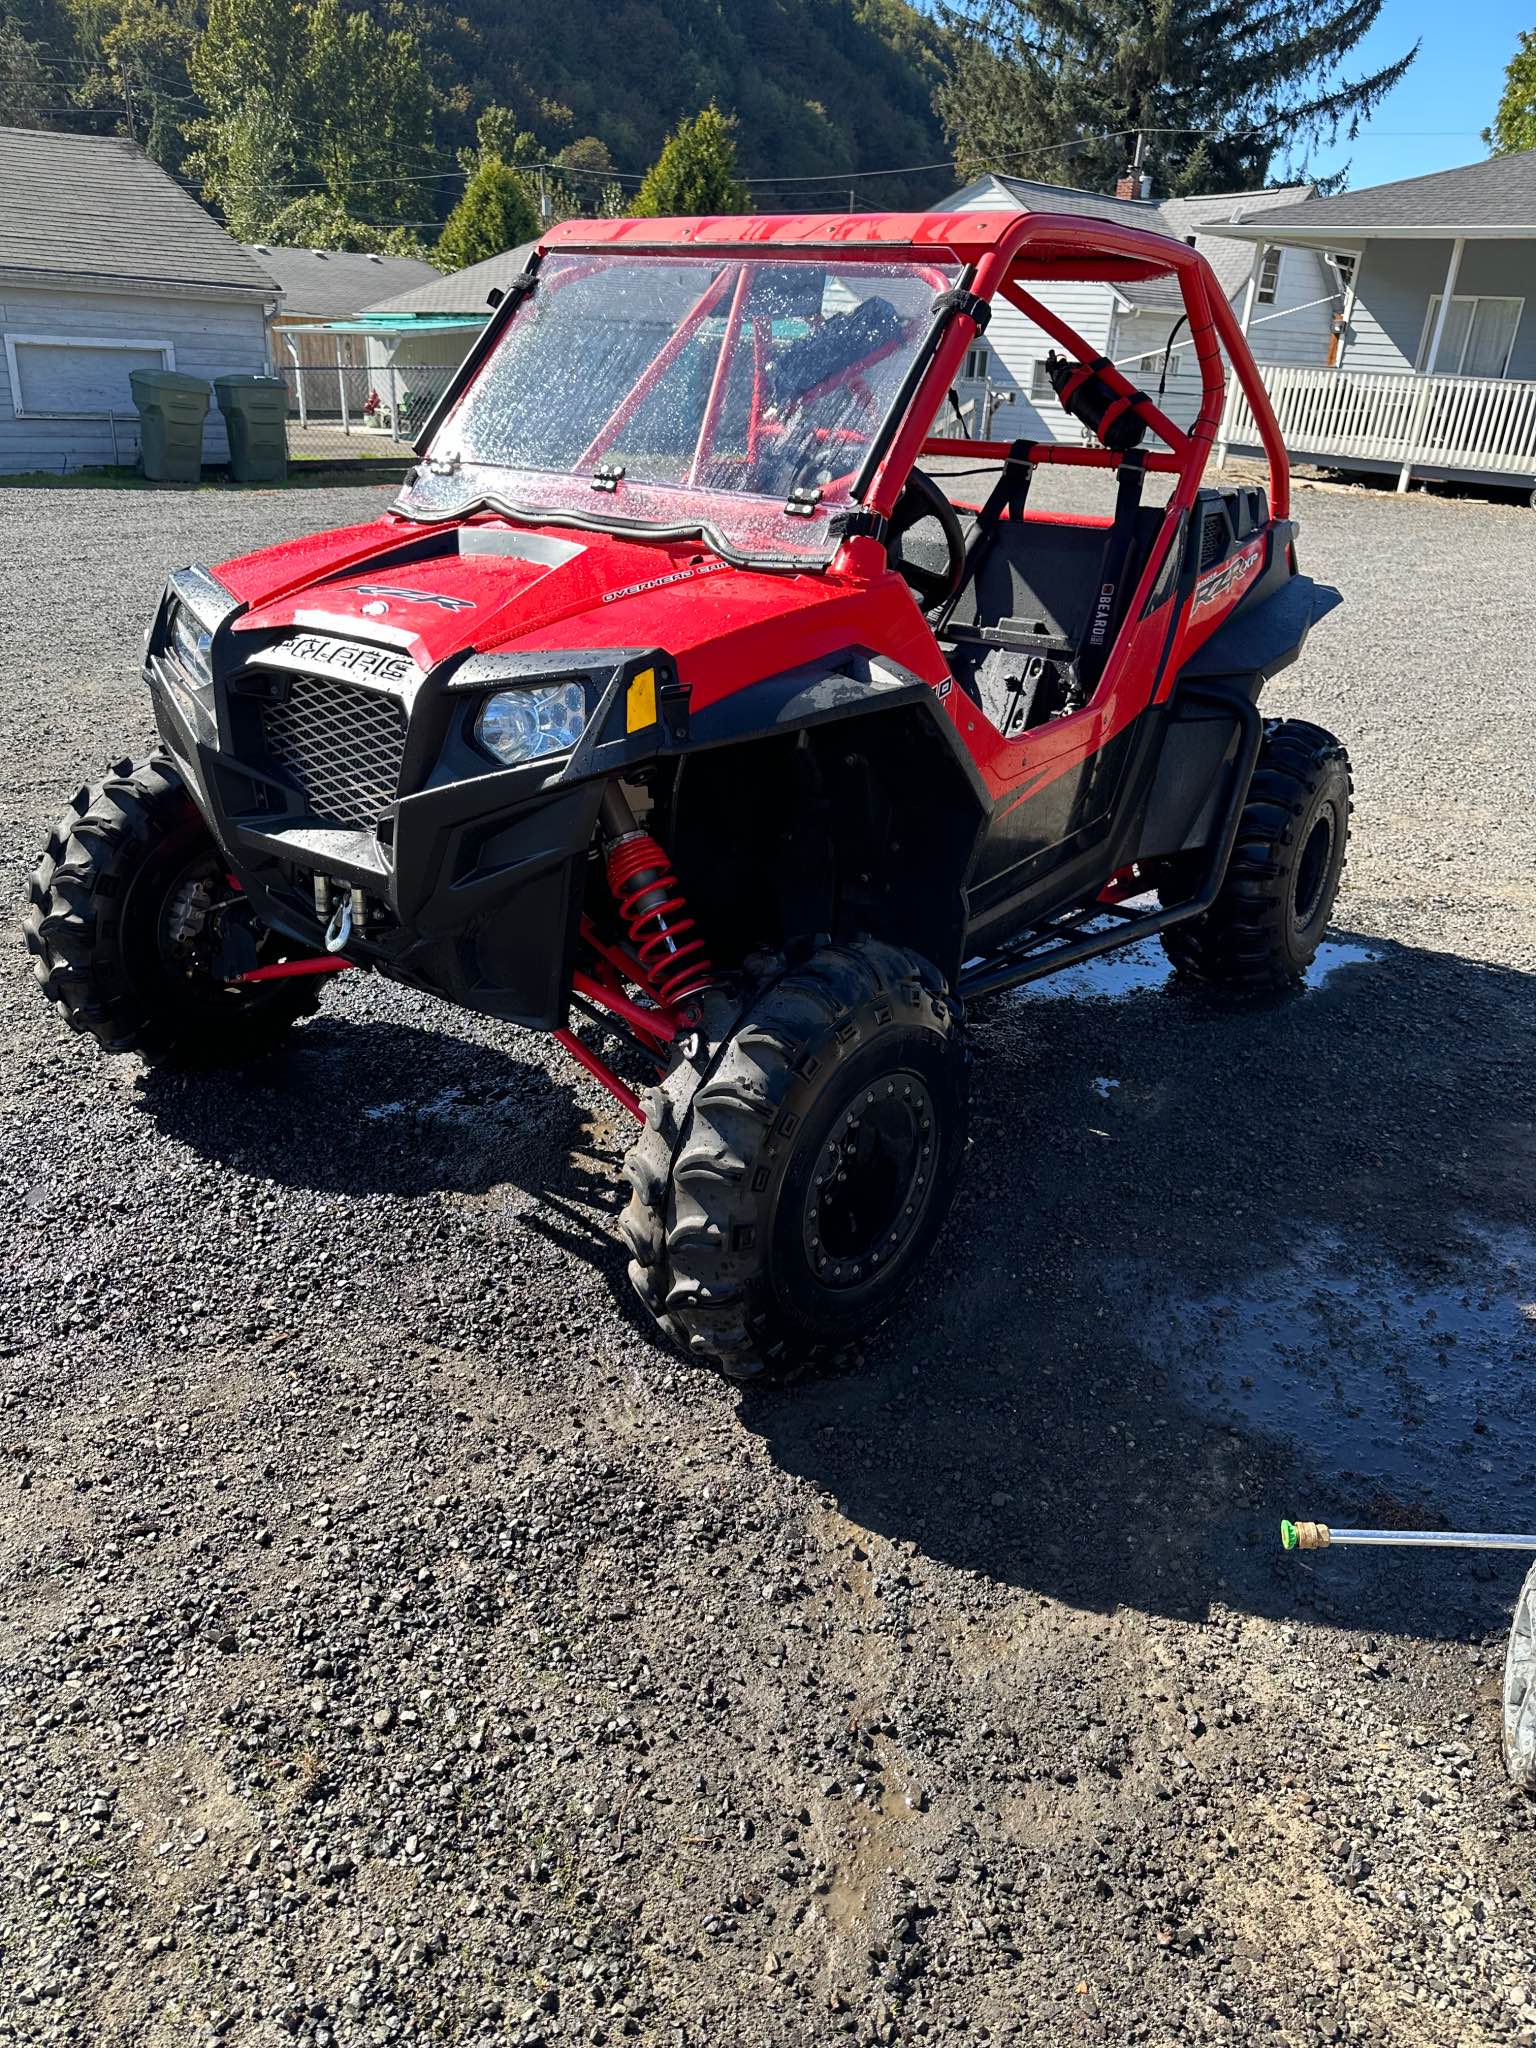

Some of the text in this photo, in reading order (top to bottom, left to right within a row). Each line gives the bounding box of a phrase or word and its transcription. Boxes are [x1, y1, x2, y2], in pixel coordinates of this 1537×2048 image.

[603, 569, 694, 602] OVERHEAD
[1190, 556, 1246, 618] RZR
[1243, 552, 1259, 572] XP
[1092, 596, 1112, 635] BEARD
[272, 634, 416, 682] POLARIS
